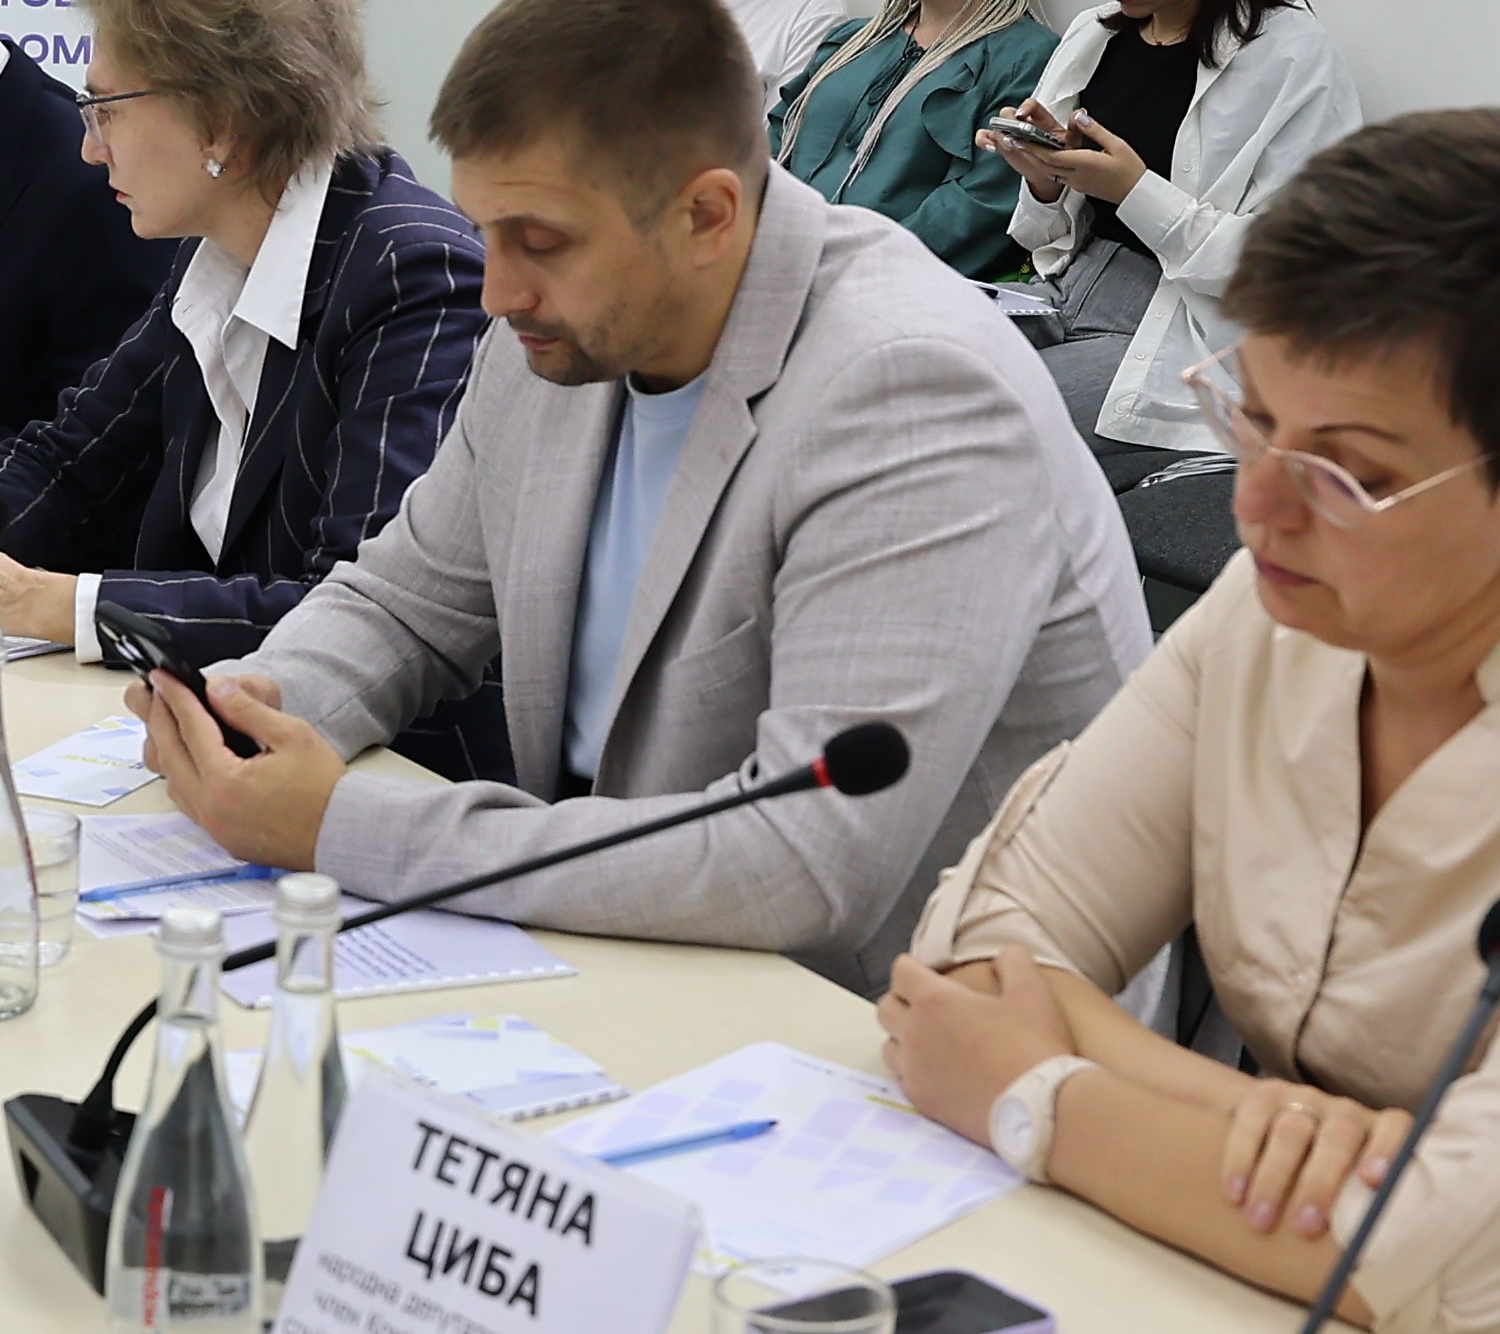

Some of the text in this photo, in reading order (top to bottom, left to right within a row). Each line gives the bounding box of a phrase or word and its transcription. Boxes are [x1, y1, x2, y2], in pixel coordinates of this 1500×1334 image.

[404, 1121, 604, 1246] ТЕТЯНА
[314, 1247, 402, 1308] народна
[403, 1210, 550, 1317] ЦИБА
[310, 1286, 363, 1330] член
